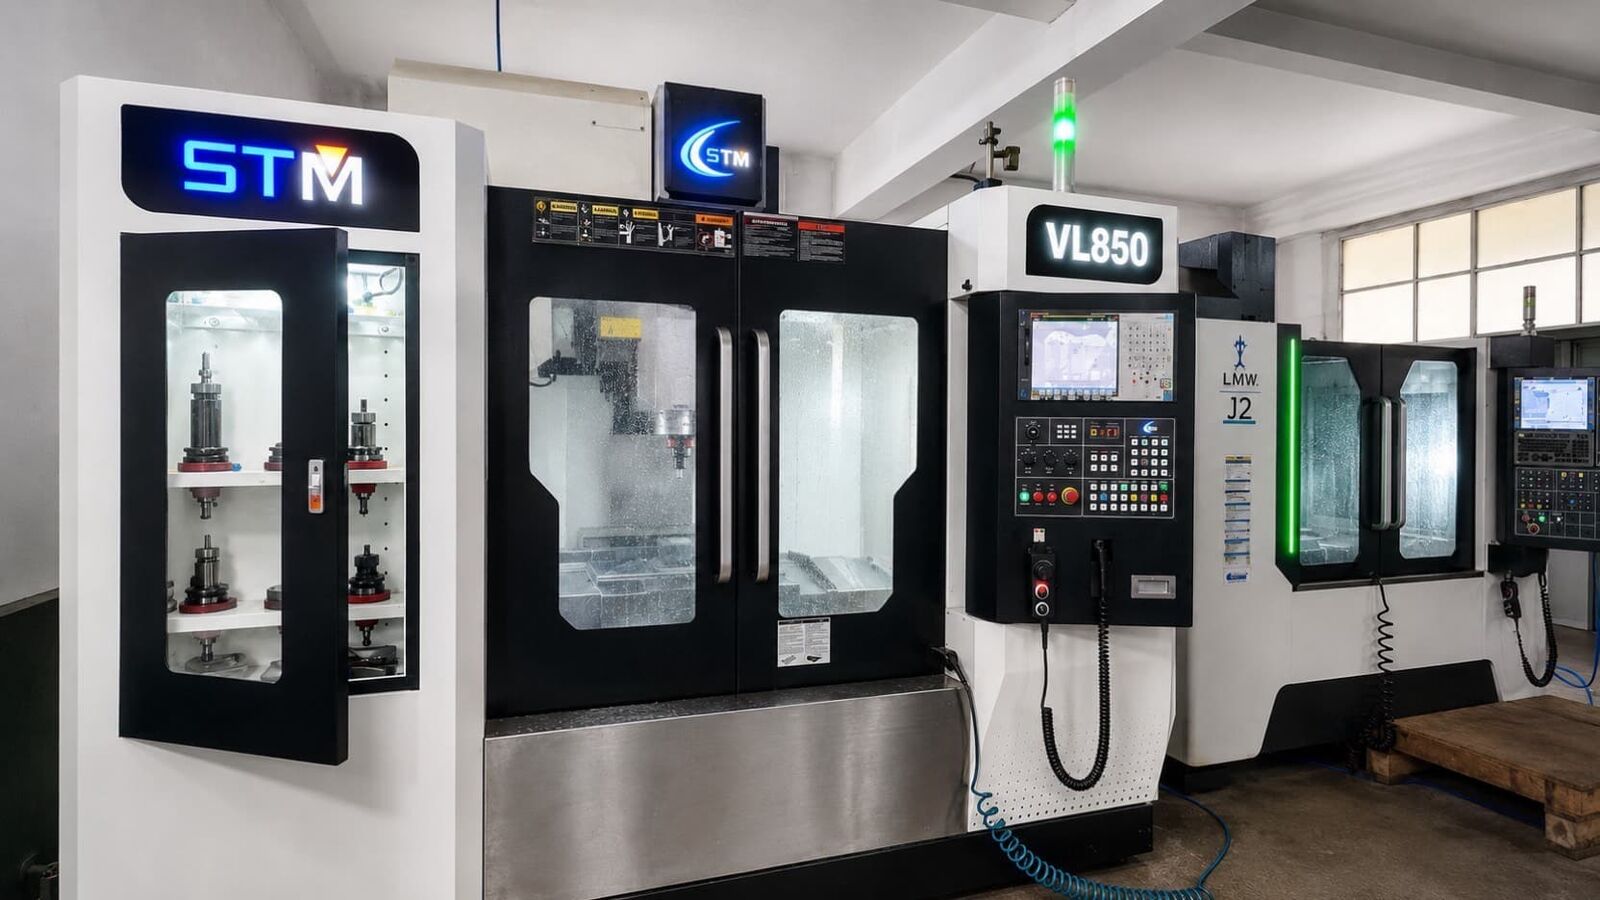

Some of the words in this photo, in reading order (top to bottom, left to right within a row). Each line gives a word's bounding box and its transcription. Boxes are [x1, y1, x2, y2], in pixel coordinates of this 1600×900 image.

[183, 139, 364, 205] STM
[706, 147, 750, 168] STM
[1045, 221, 1149, 267] VL850
[1227, 396, 1252, 420] J2
